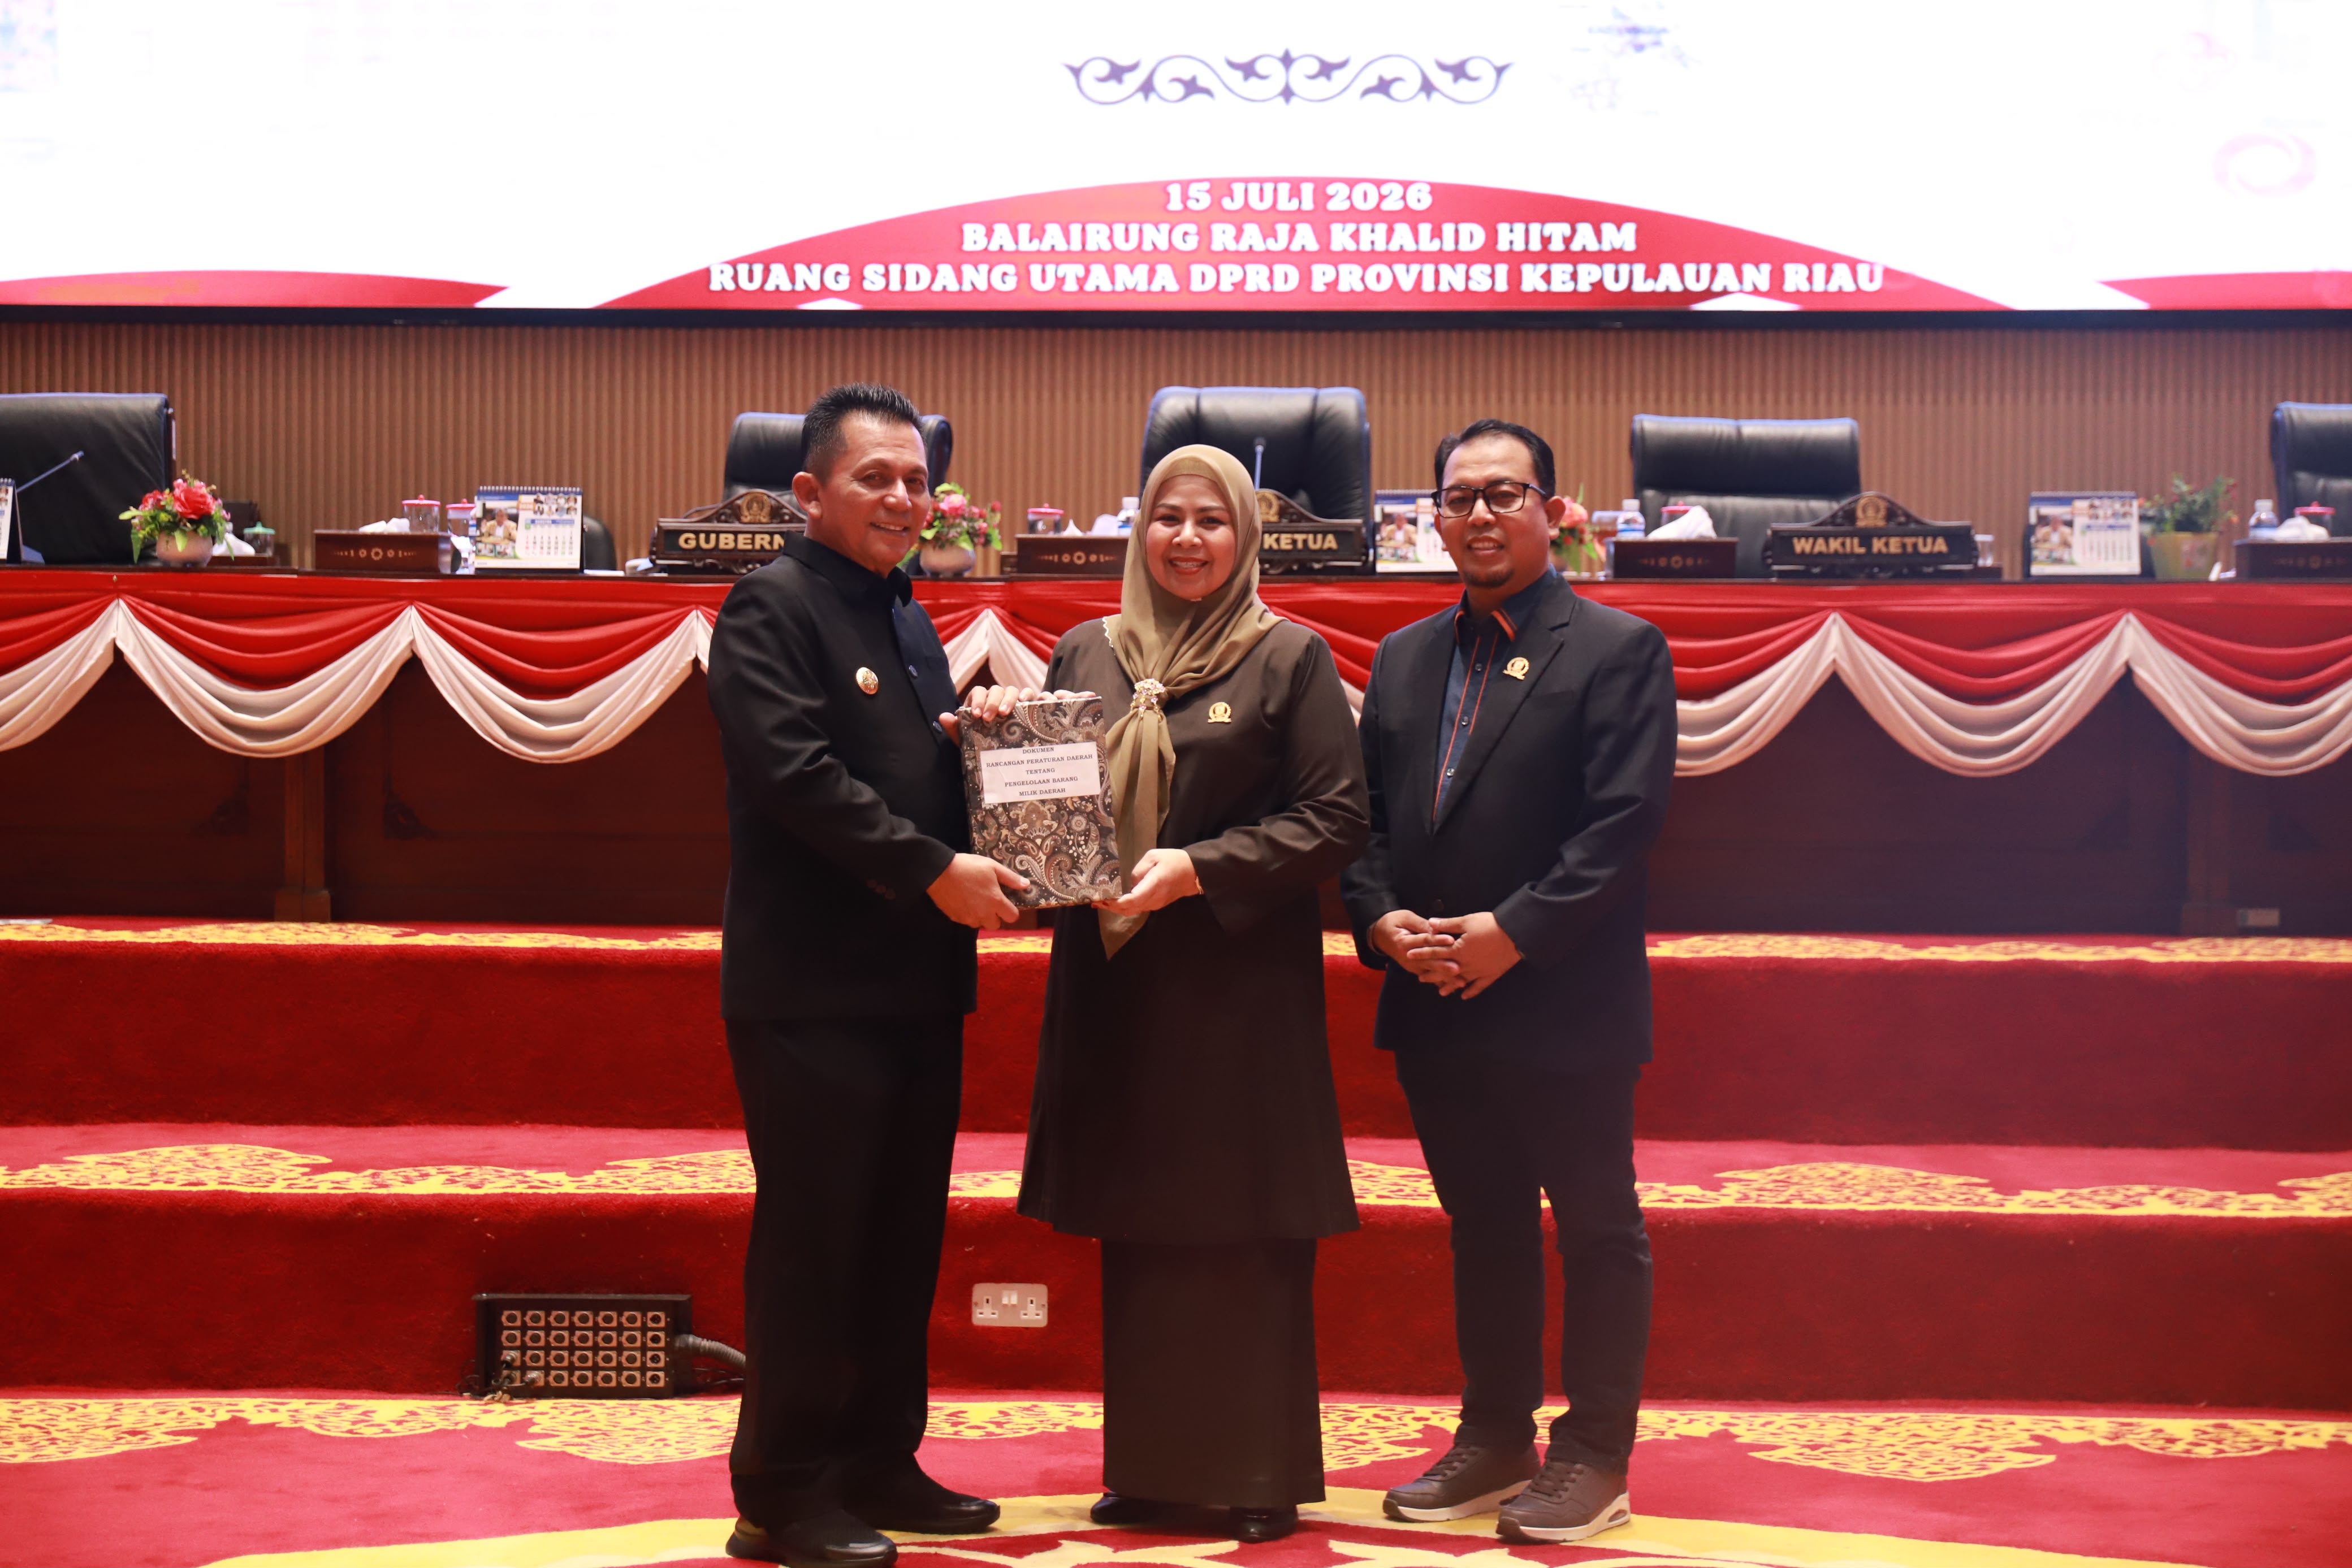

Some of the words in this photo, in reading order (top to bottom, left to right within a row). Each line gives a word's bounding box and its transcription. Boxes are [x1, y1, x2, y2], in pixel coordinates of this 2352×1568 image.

[1166, 183, 1211, 211] 15
[1221, 183, 1314, 211] JULI
[1326, 182, 1432, 211] 2026
[962, 223, 1199, 252] BALAIRUNG
[1210, 223, 1320, 252] RAJA
[1330, 223, 1486, 252] KHALID
[1497, 222, 1637, 252] HITAM
[708, 263, 850, 291] RUANG
[863, 263, 1018, 292] SIDANG
[1028, 263, 1180, 292] UTAMA
[1190, 263, 1300, 292] DPRD
[1311, 263, 1508, 292] PROVINSI
[1521, 263, 1771, 292] KEPULAUAN
[1783, 262, 1883, 292] RIAU
[678, 532, 784, 550] GUBERN
[1263, 533, 1338, 550] KETUA
[1792, 537, 1866, 555] WAKIL
[1871, 536, 1949, 554] KETUA
[1027, 756, 1065, 765] PERATURAN
[1005, 779, 1050, 787] PENGELOLAAN
